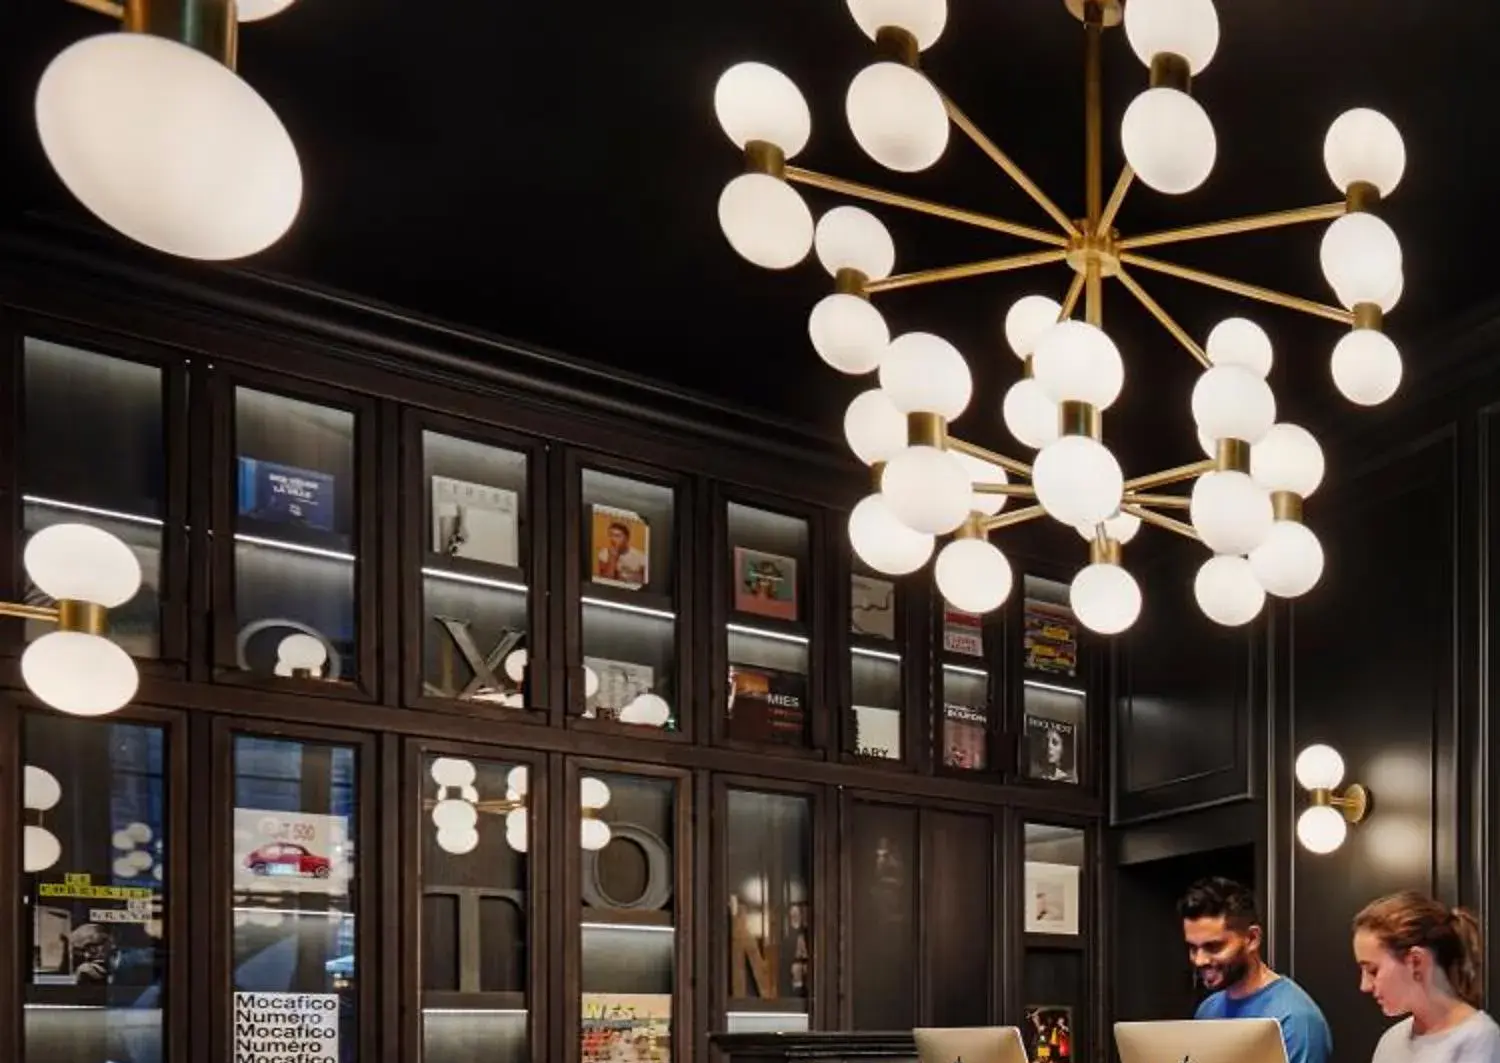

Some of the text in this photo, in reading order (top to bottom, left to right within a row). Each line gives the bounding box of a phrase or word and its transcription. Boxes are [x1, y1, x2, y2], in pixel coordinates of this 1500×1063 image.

[236, 994, 336, 1011] Mocafico
[236, 1009, 323, 1024] Numéro
[236, 1023, 335, 1039] Mocafico
[236, 1038, 322, 1053] Numéro
